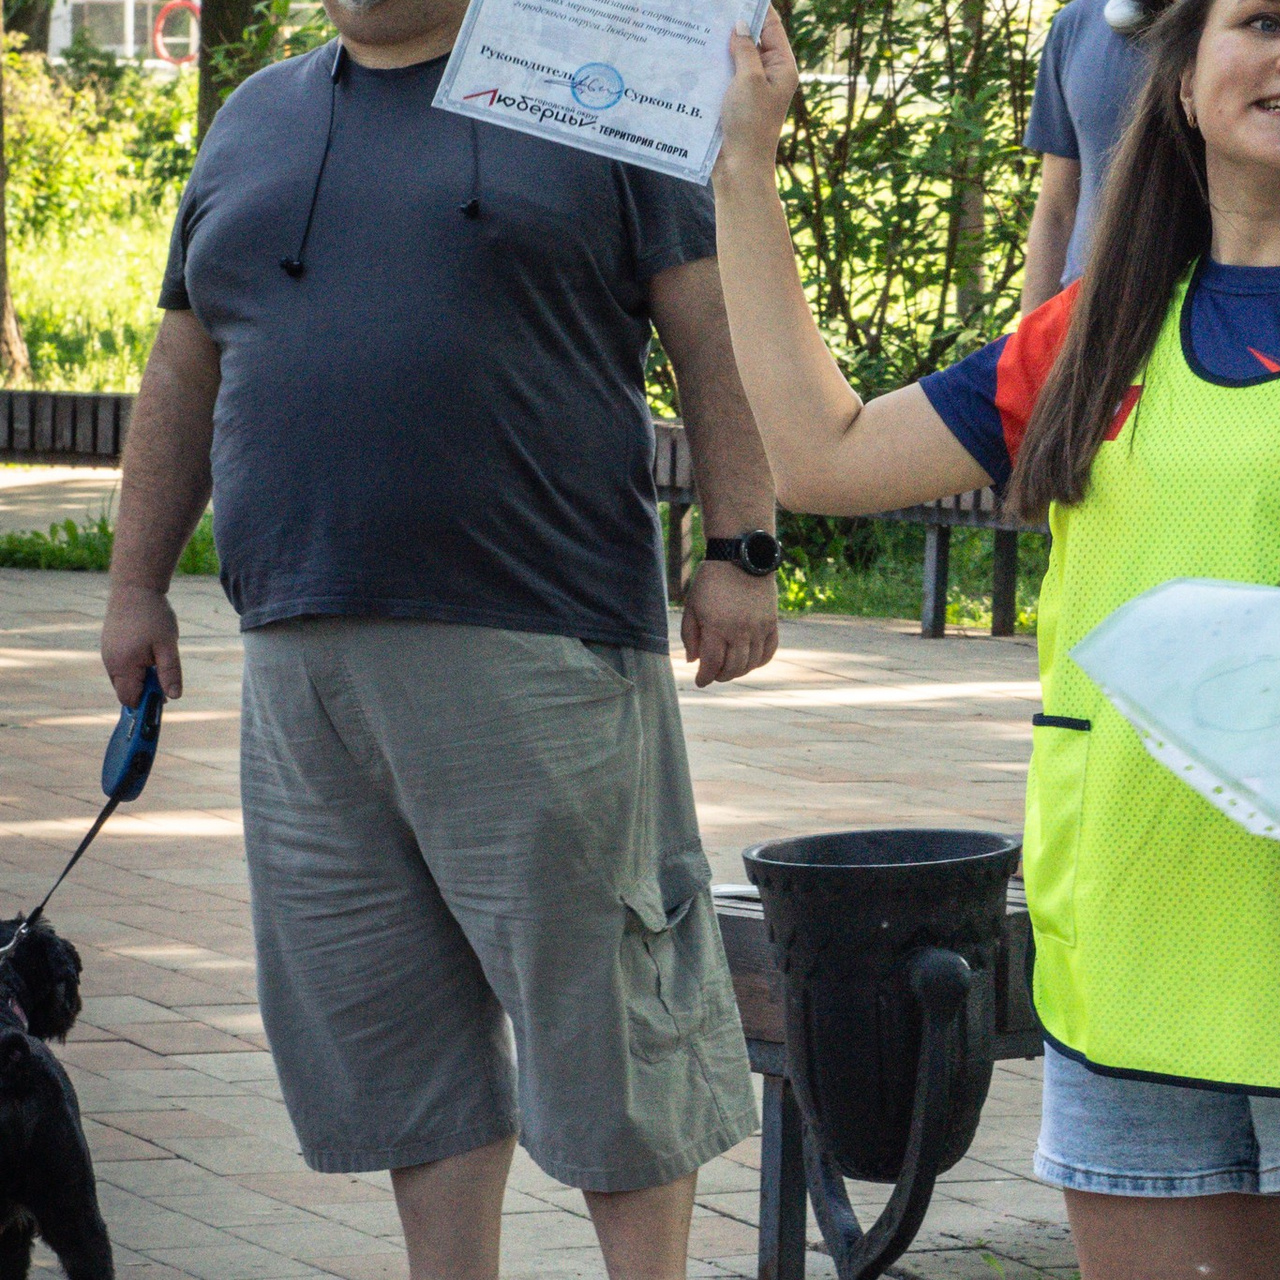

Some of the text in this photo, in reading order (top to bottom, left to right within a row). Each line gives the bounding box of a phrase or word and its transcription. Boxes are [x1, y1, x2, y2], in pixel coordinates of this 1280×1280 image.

[563, 0, 632, 27] мероприятий
[631, 19, 644, 29] на
[644, 23, 707, 48] территории
[567, 15, 601, 32] округа
[600, 22, 648, 45] Люберцы
[640, 7, 701, 32] спортивных
[703, 26, 711, 34] и
[478, 43, 577, 82] Руководитель
[622, 86, 674, 112] Сурков
[675, 102, 704, 119] В.В.
[463, 87, 598, 128] Люберцы
[598, 124, 654, 148] ТЕРРИТОРИЯ
[654, 140, 689, 159] СПОРТА
[533, 97, 599, 122] городской округ
